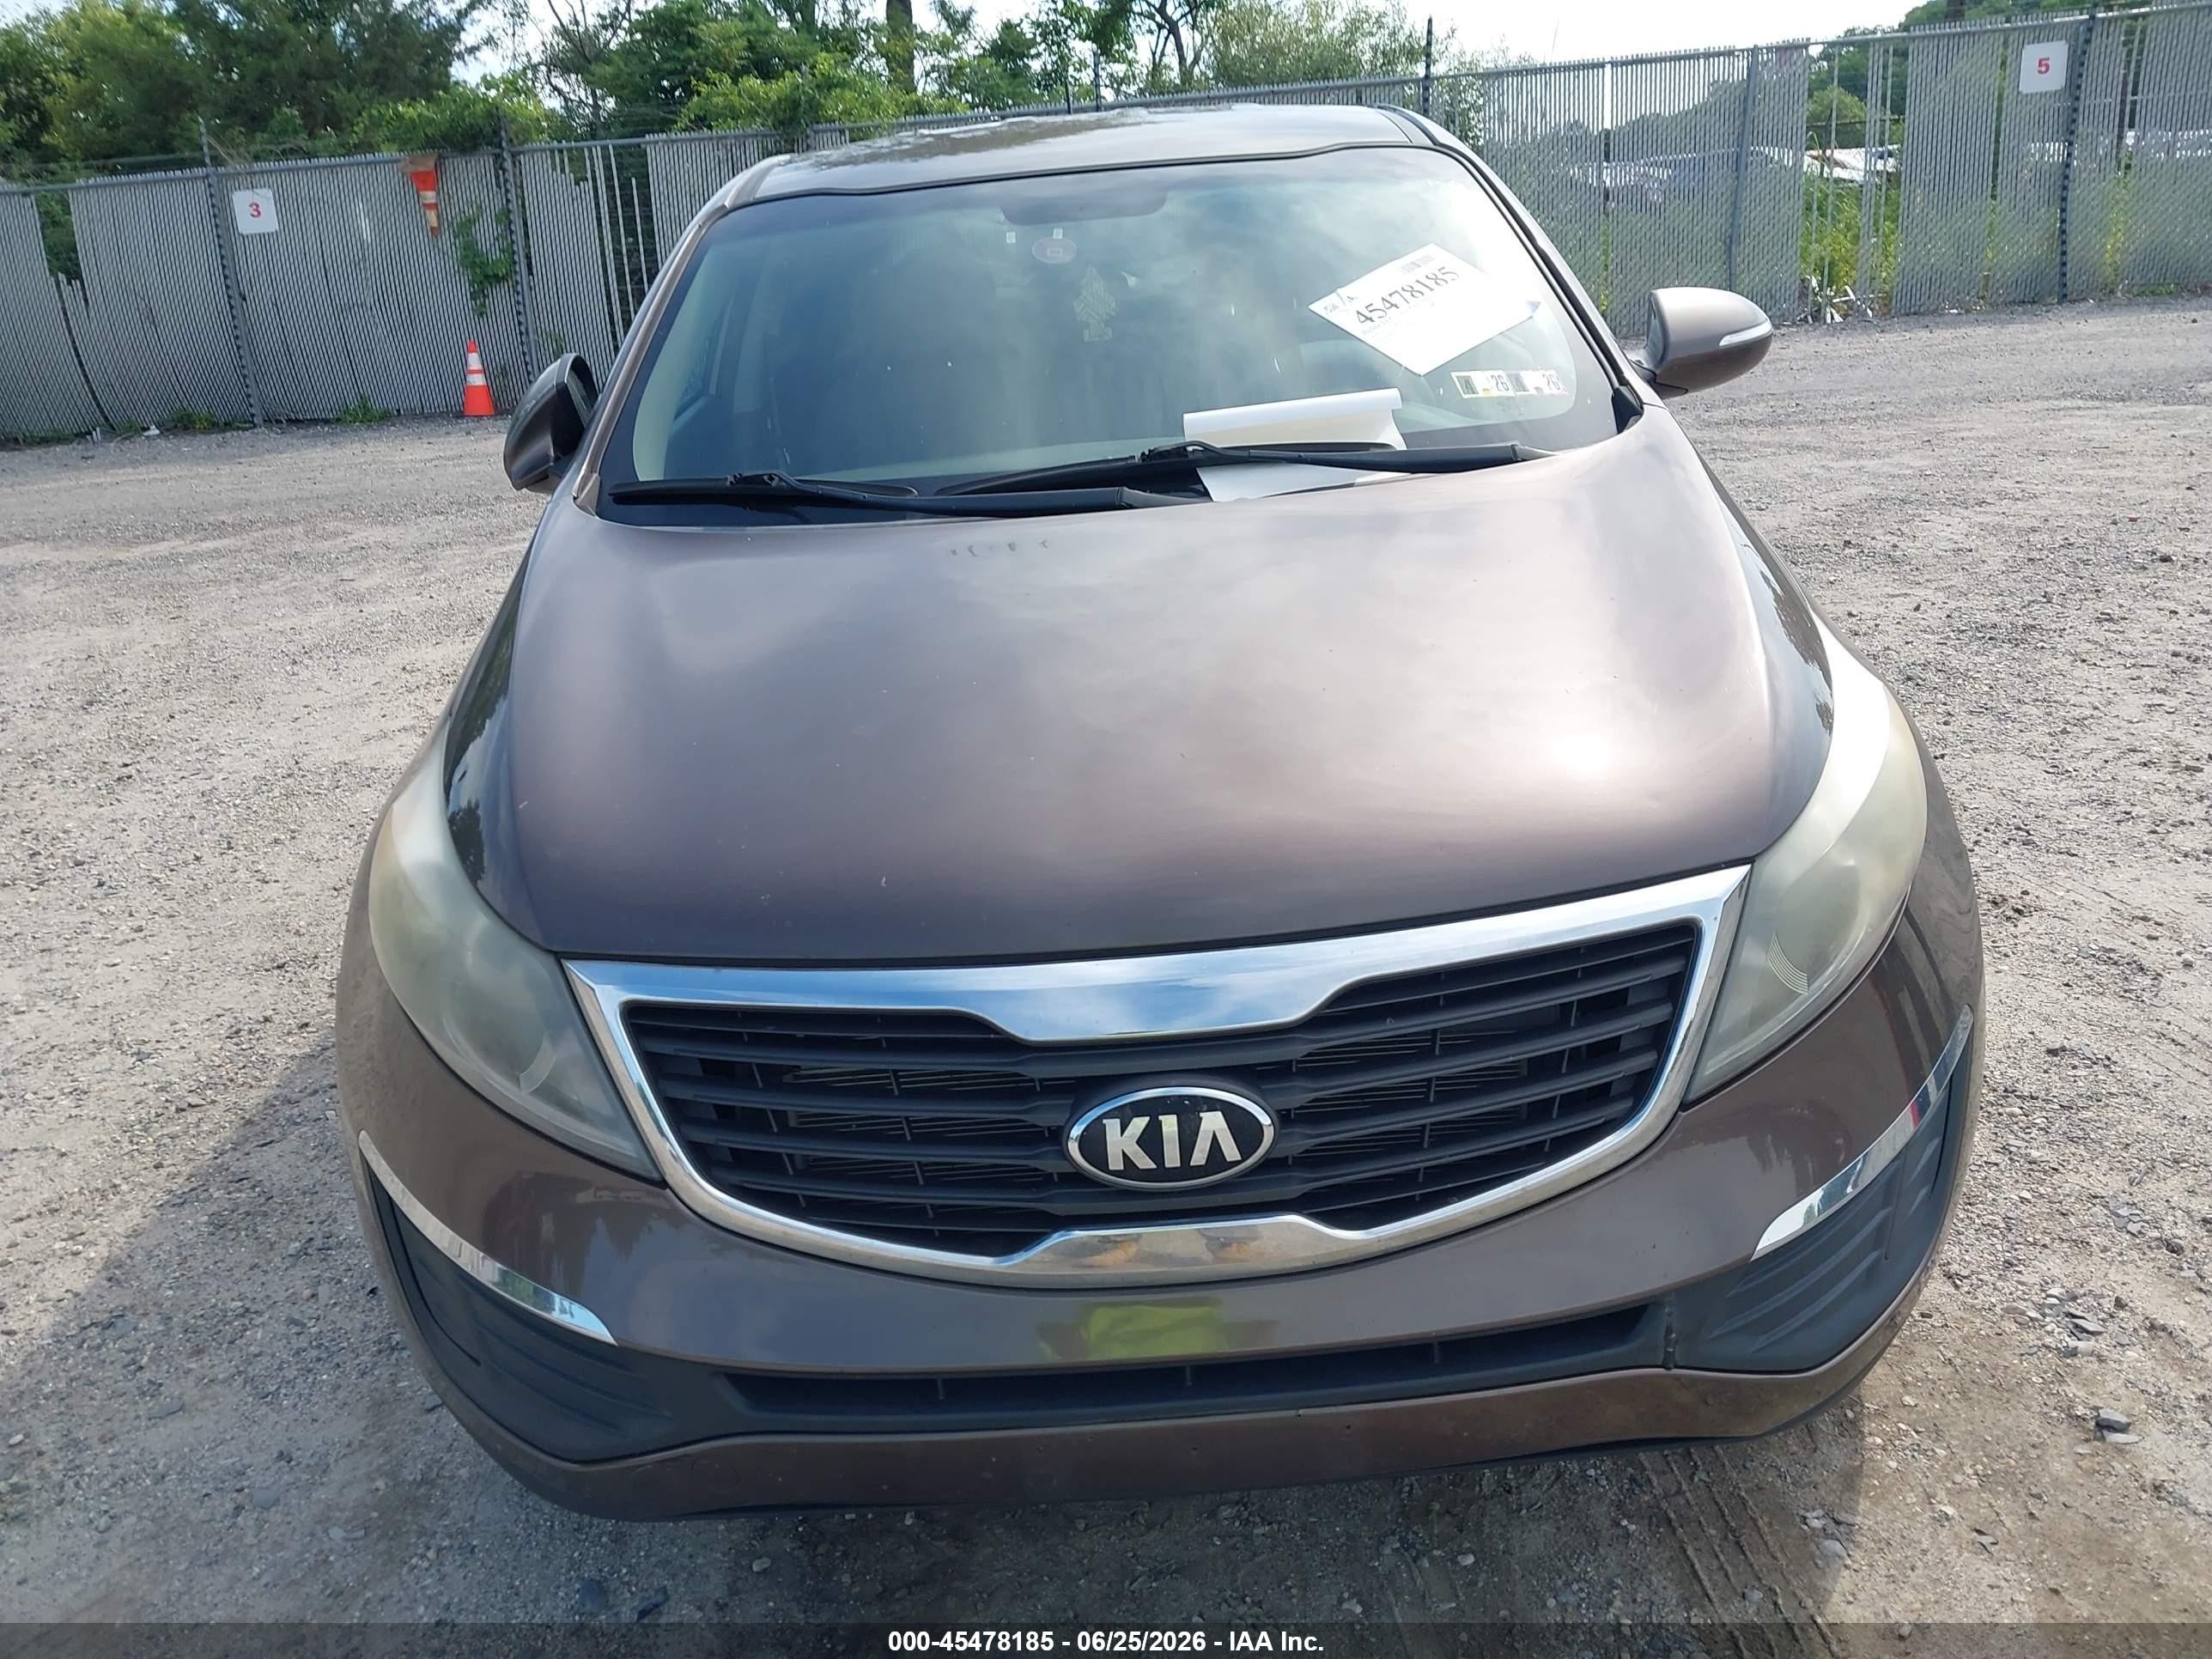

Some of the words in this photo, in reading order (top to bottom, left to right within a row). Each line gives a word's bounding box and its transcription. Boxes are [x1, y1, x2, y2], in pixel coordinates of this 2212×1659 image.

[2037, 57, 2051, 75] 5
[248, 202, 262, 218] 3
[1356, 265, 1460, 325] 45478185
[1103, 1110, 1243, 1171] KIA
